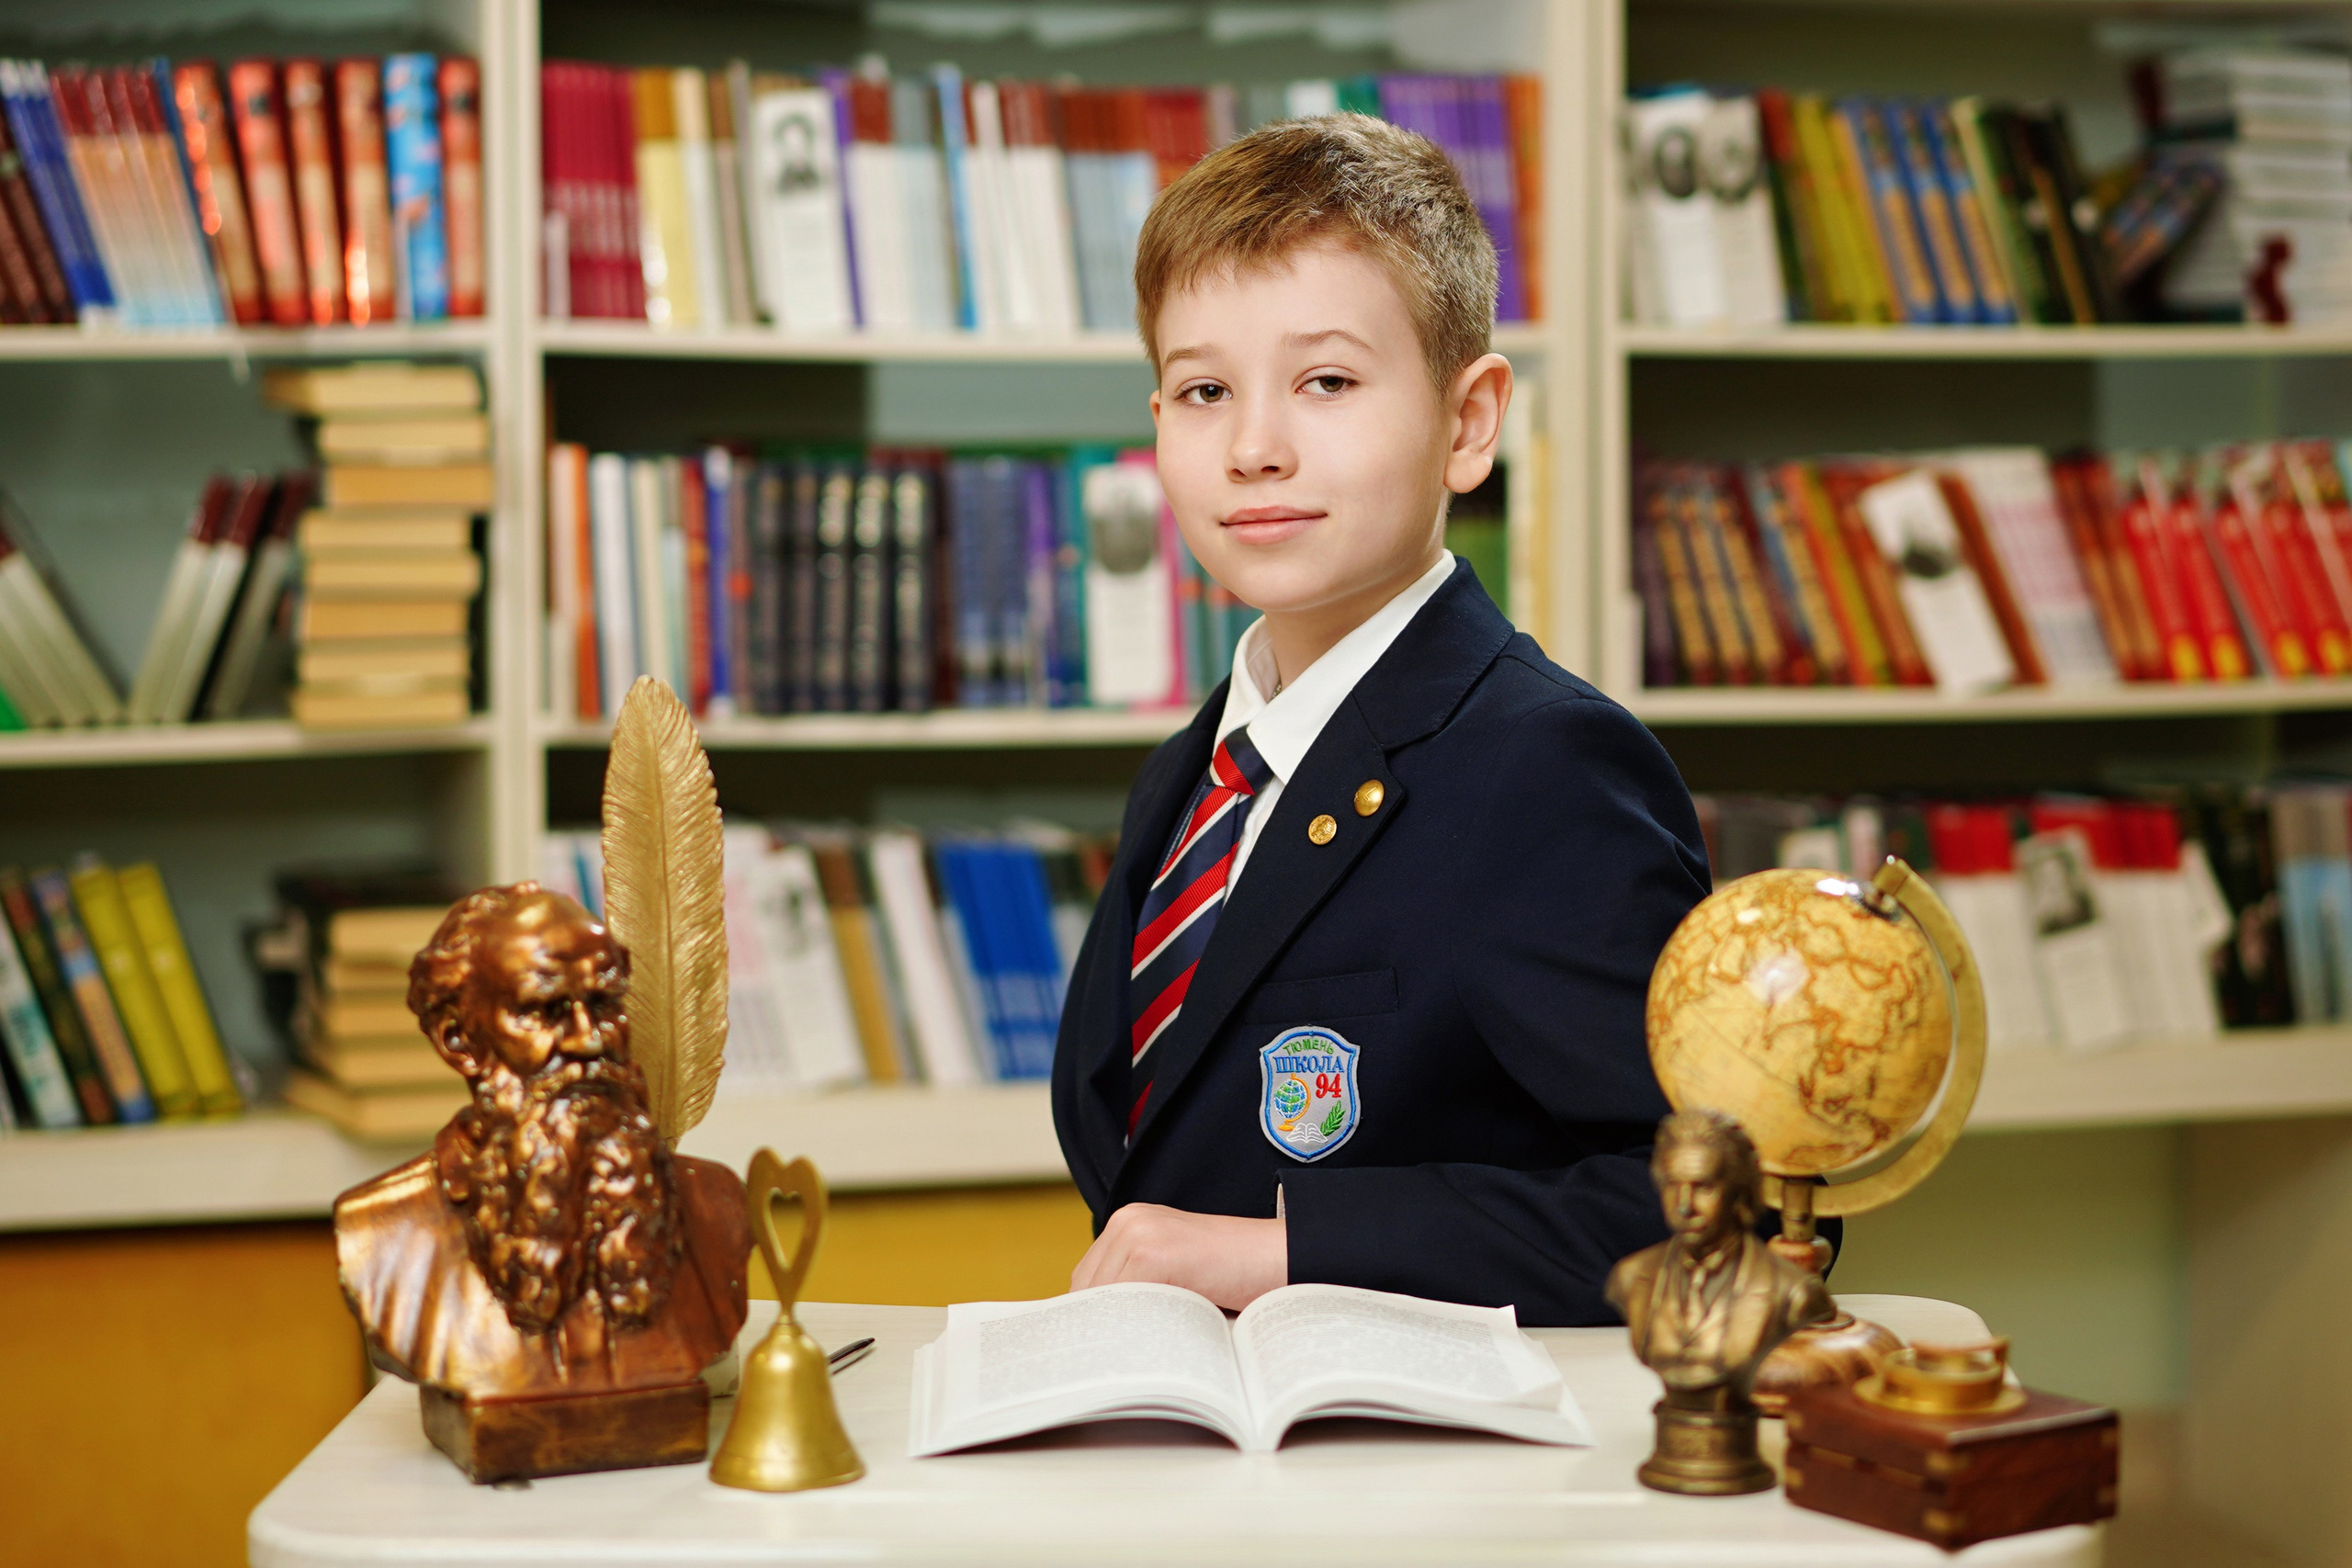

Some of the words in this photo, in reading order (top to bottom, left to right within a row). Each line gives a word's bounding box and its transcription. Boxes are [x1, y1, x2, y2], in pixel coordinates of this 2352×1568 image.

[1283, 1039, 1334, 1055] ТЮМЕНЬ
[1273, 1055, 1345, 1073] ШКОЛА
[1316, 1073, 1341, 1099] 94
